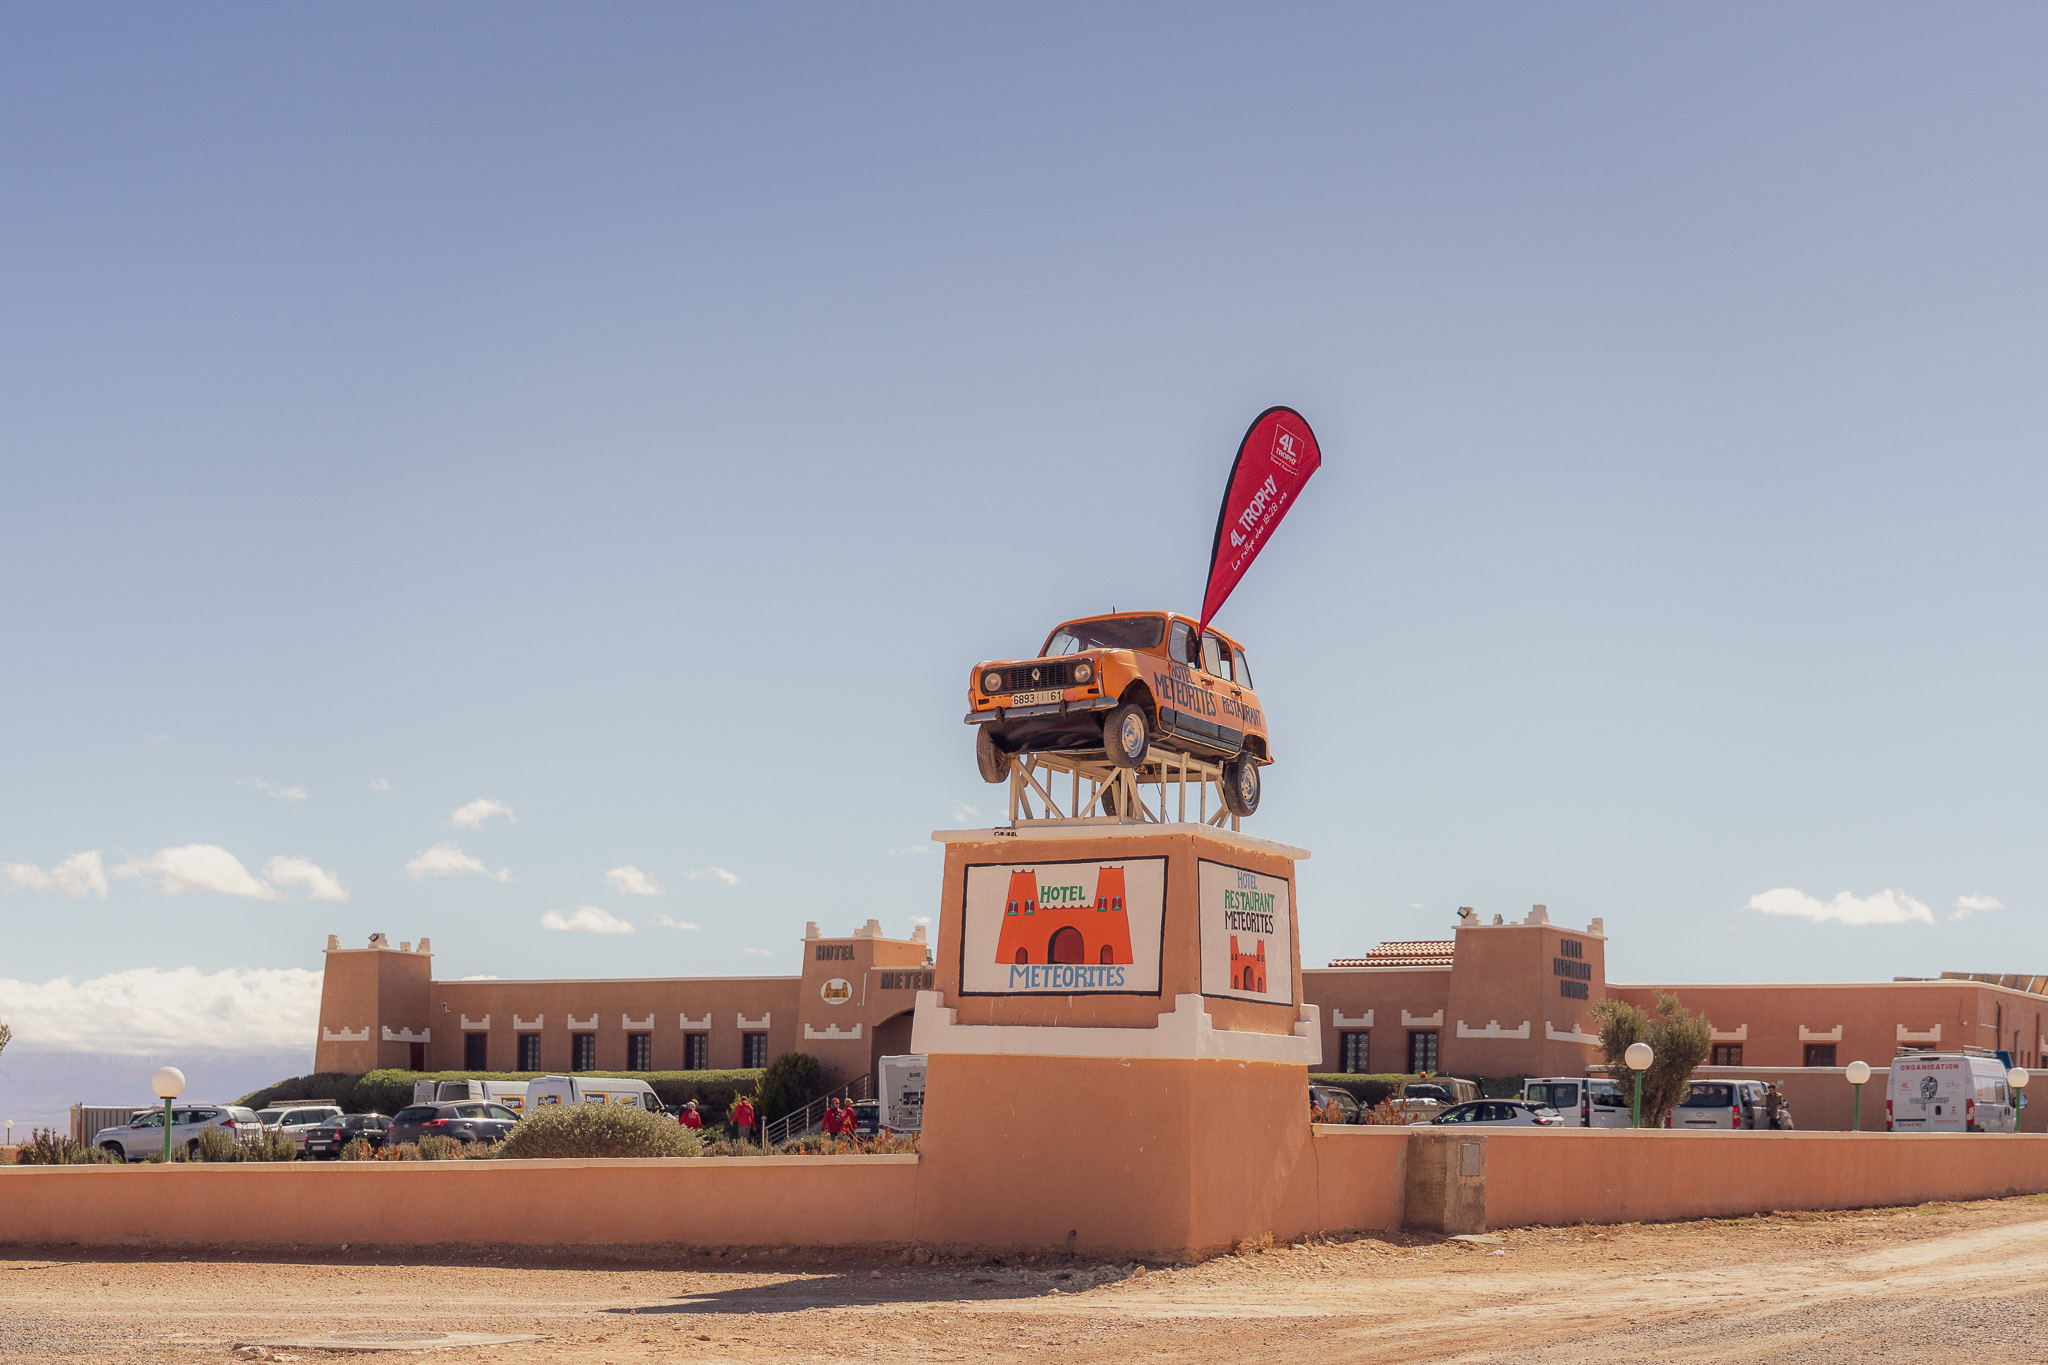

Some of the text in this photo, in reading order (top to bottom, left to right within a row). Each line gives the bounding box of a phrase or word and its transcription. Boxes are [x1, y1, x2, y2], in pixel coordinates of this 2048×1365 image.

[1275, 447, 1297, 465] TROPHY
[1279, 433, 1296, 457] 4L
[1230, 474, 1278, 548] 4L TROPHY
[1231, 491, 1288, 571] Le rallye des 18-28 ans
[1170, 661, 1196, 685] HOTEL
[1013, 690, 1061, 705] 6893 61
[1153, 671, 1262, 728] METEORITES RESTAURANT
[1236, 870, 1258, 890] HOTEL
[1039, 885, 1086, 904] HOTEL
[1224, 888, 1275, 914] RESTAURANT
[1224, 910, 1274, 935] METEORITES
[815, 944, 855, 961] HOTEL
[1560, 938, 1584, 959] HOTEL
[1008, 964, 1125, 989] METEORITES
[1900, 1062, 1959, 1072] ORGANISATION
[502, 1099, 520, 1109] Berger
